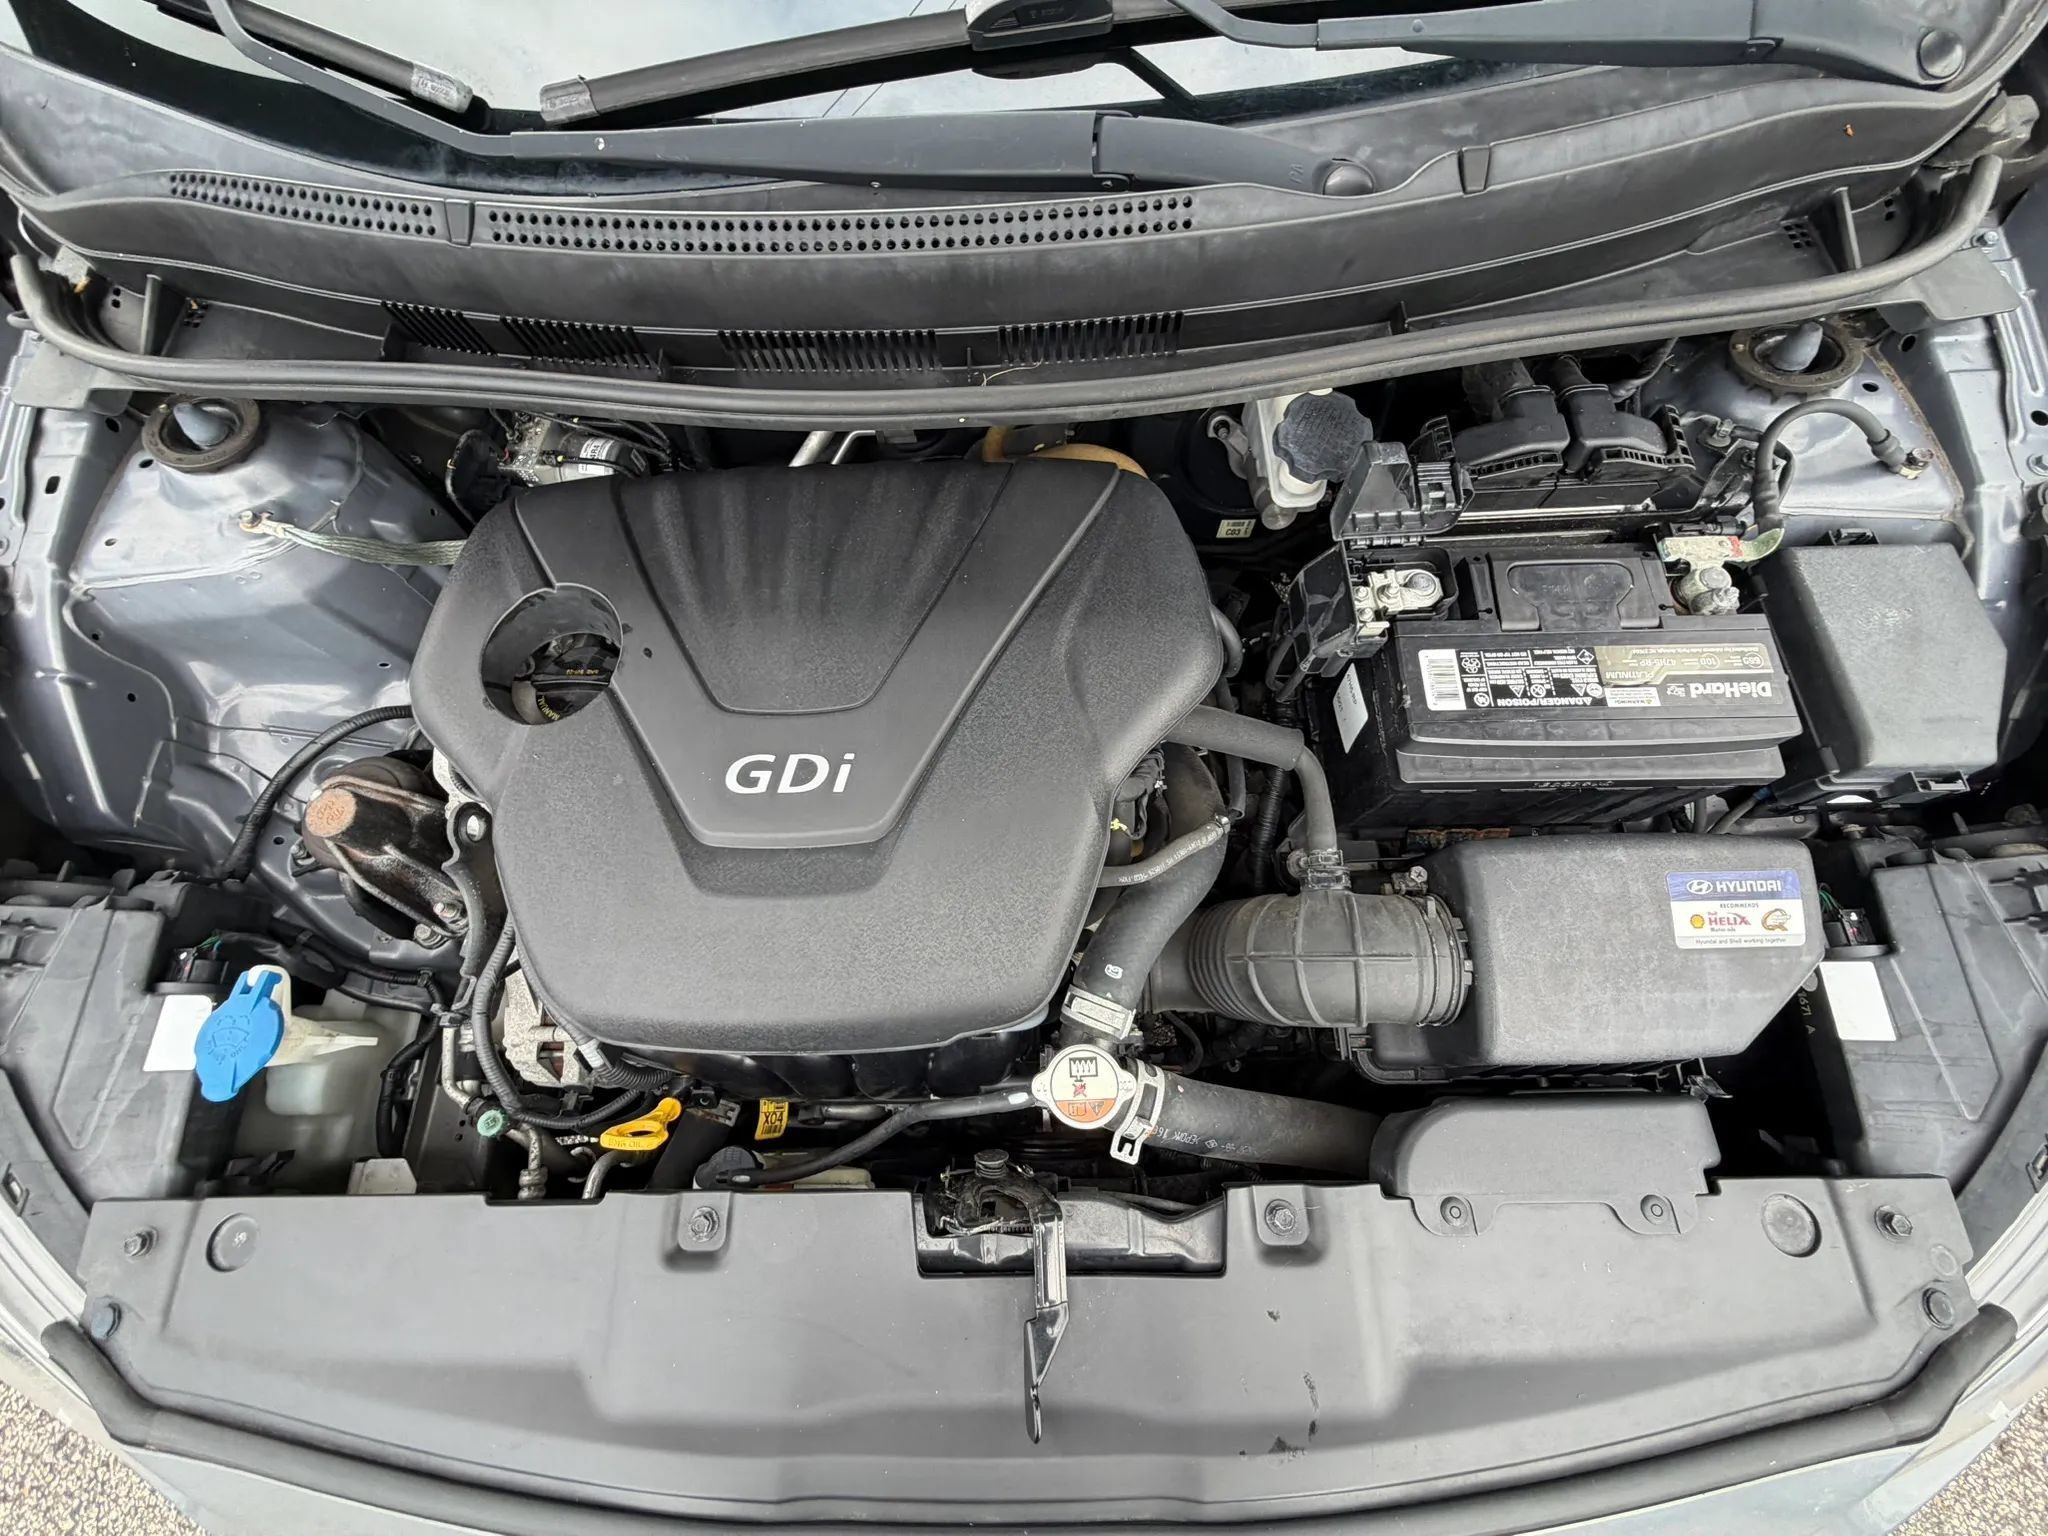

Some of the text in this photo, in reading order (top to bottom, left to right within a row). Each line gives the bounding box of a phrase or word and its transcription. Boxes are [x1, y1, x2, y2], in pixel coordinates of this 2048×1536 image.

[1605, 671, 1656, 679] PLATINUM
[1689, 682, 1773, 698] DieHard
[725, 752, 856, 794] GDi
[1716, 879, 1783, 893] HYUNDAI
[1708, 914, 1751, 926] HELIX
